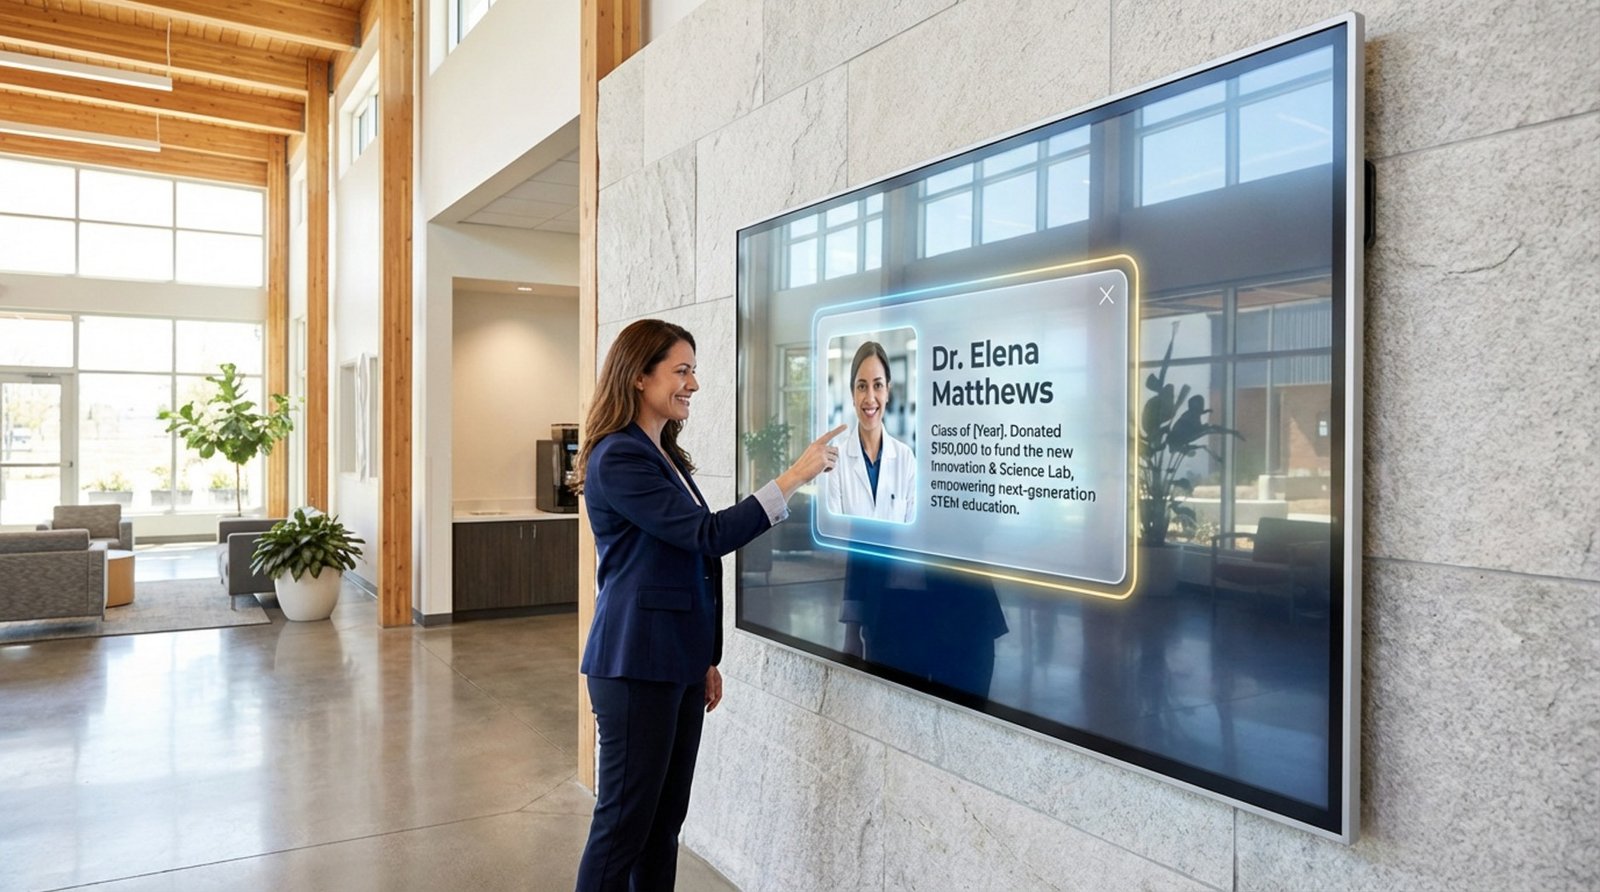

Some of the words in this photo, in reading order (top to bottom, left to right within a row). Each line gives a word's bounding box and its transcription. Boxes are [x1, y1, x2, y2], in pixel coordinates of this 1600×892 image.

[933, 346, 963, 371] Dr.
[971, 339, 1039, 368] Elena
[932, 377, 1054, 406] Matthews
[959, 423, 971, 437] of
[973, 423, 1007, 440] [Year].
[1010, 423, 1062, 438] Donated
[931, 441, 978, 456] $150,000
[981, 444, 992, 456] to
[994, 443, 1021, 457] fund
[1023, 444, 1043, 458] the
[1047, 447, 1074, 459] new
[931, 460, 986, 474] Innovation
[988, 462, 997, 475] &
[999, 462, 1045, 478] Science
[1048, 464, 1074, 481] Lab,
[930, 480, 996, 497] empowering
[962, 498, 1020, 515] education.
